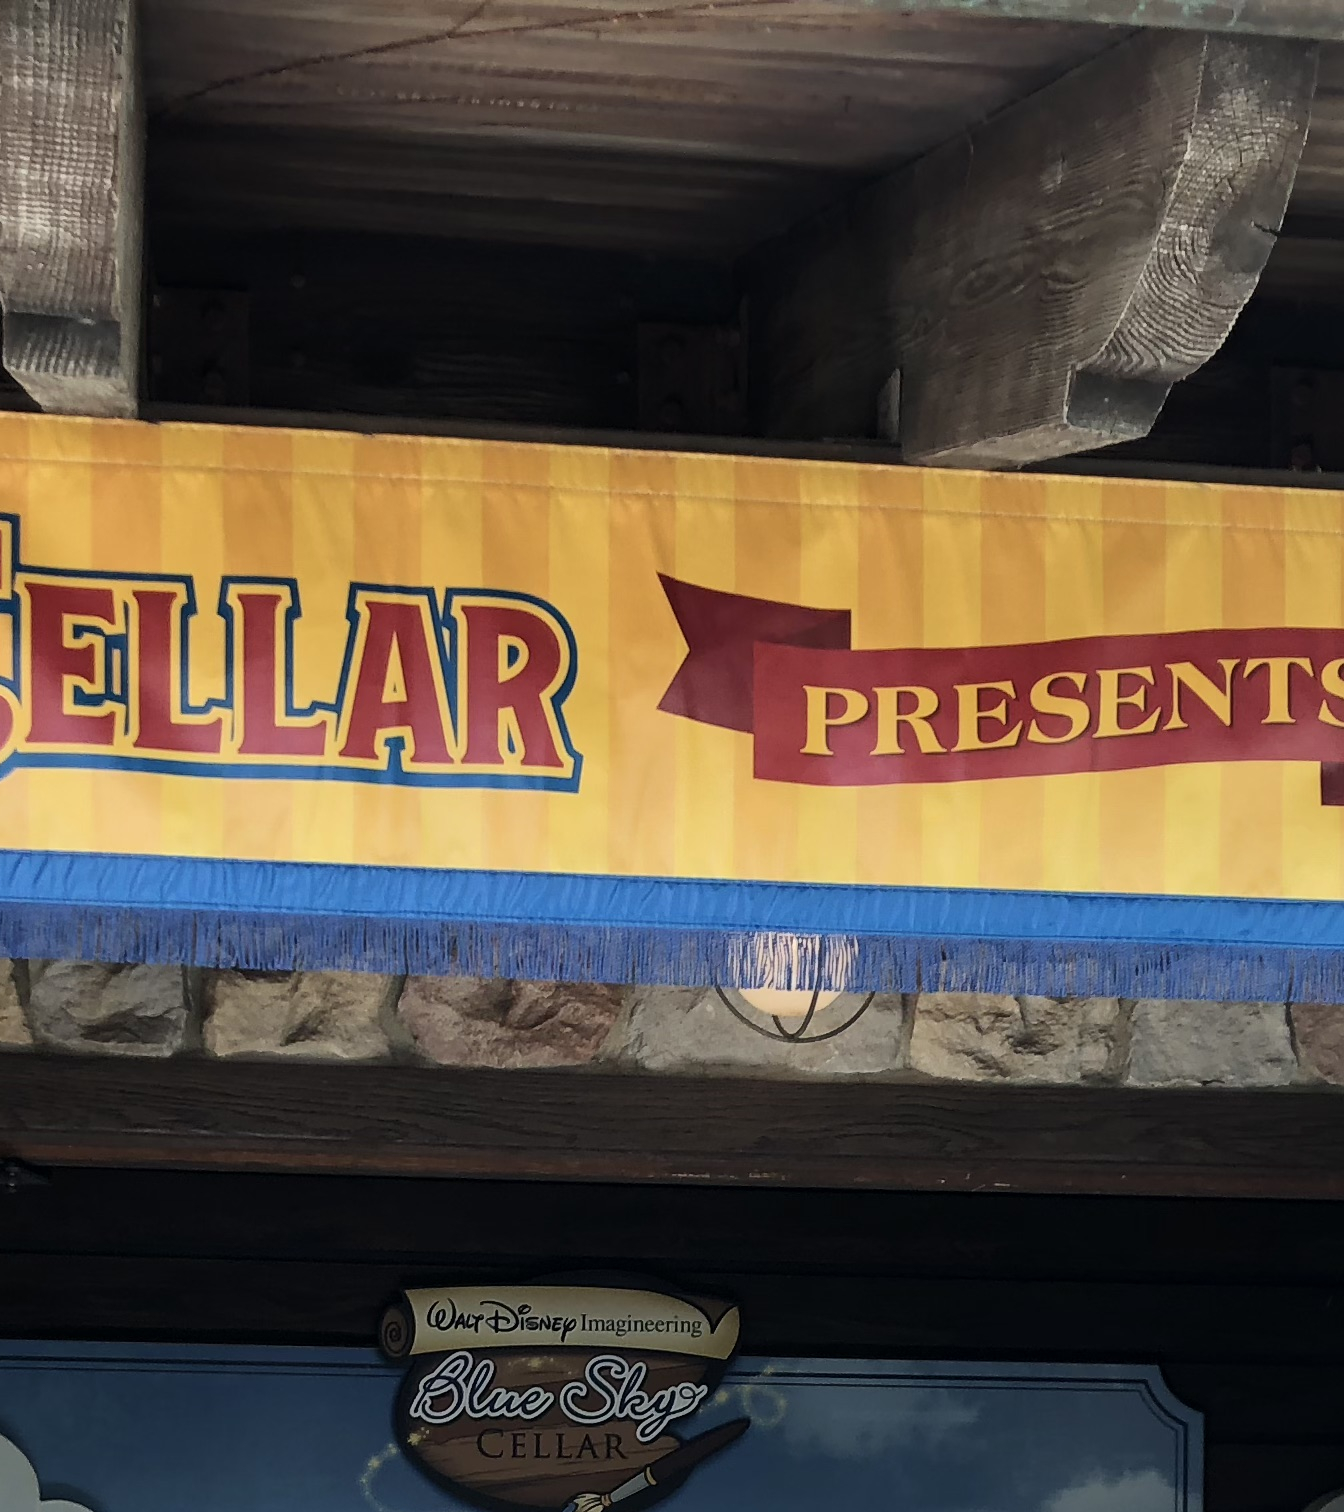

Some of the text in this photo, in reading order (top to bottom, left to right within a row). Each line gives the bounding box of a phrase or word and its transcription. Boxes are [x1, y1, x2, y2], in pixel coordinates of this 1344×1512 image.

[427, 1299, 484, 1333] WALT
[581, 1314, 702, 1337] Imagineering
[409, 1351, 708, 1442] Blue Sky
[476, 1429, 628, 1459] CELLAR
